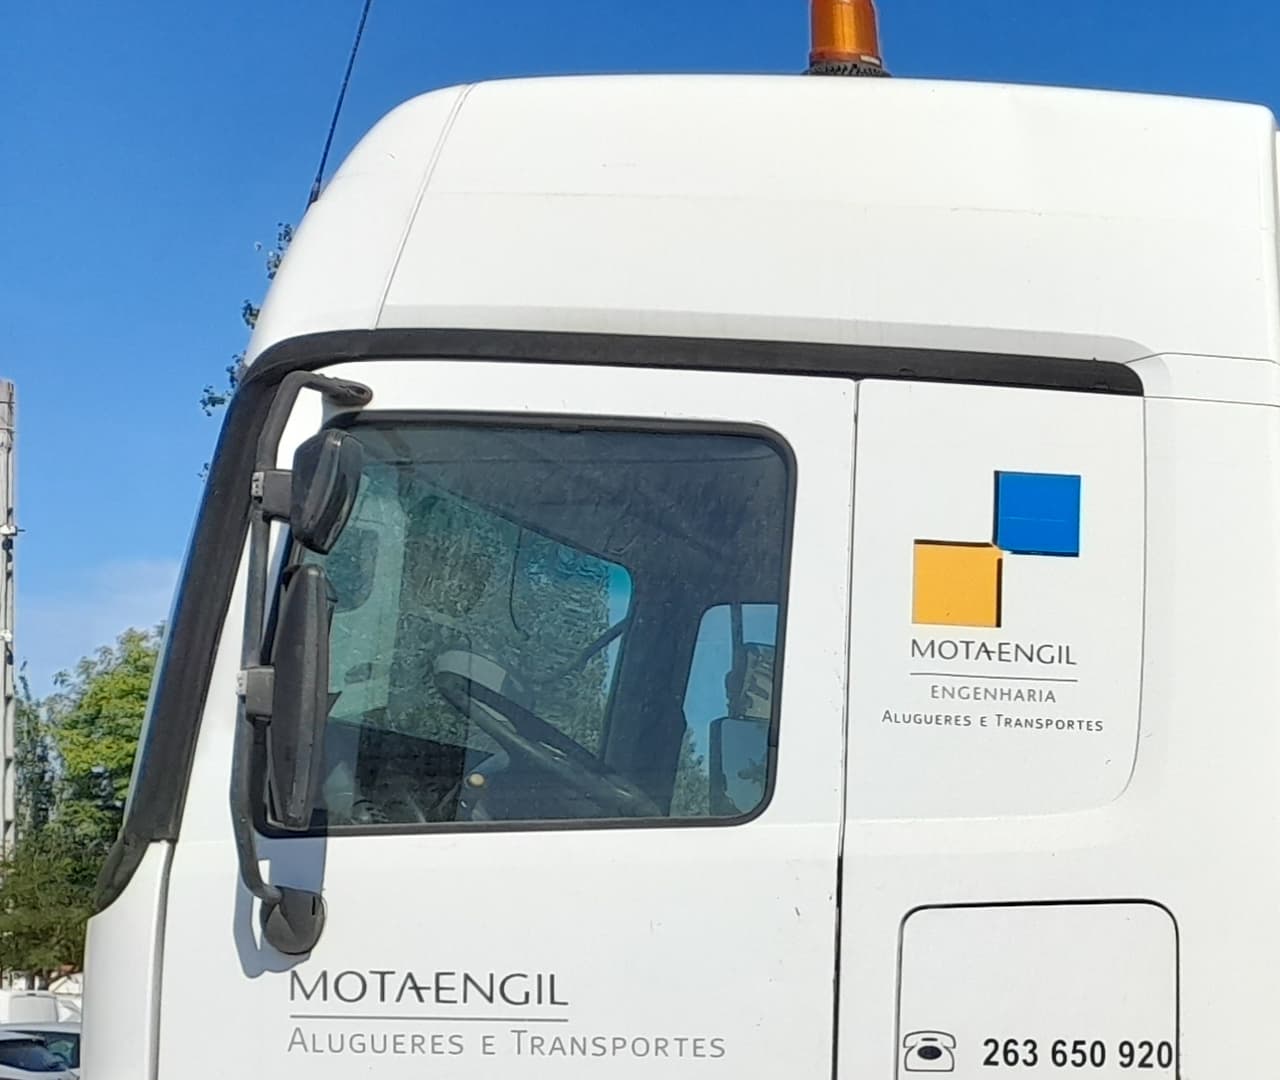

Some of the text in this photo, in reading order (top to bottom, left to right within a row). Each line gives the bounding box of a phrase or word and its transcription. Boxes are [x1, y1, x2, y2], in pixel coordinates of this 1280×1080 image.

[930, 684, 1057, 704] ENGENHARIA
[881, 709, 972, 727] ALUGUERES
[995, 714, 1104, 732] TRANSPORTES
[287, 1027, 465, 1056] ALUGUERES
[511, 1029, 727, 1059] TRANSPORTES
[982, 1038, 1174, 1069] 263 650 920
